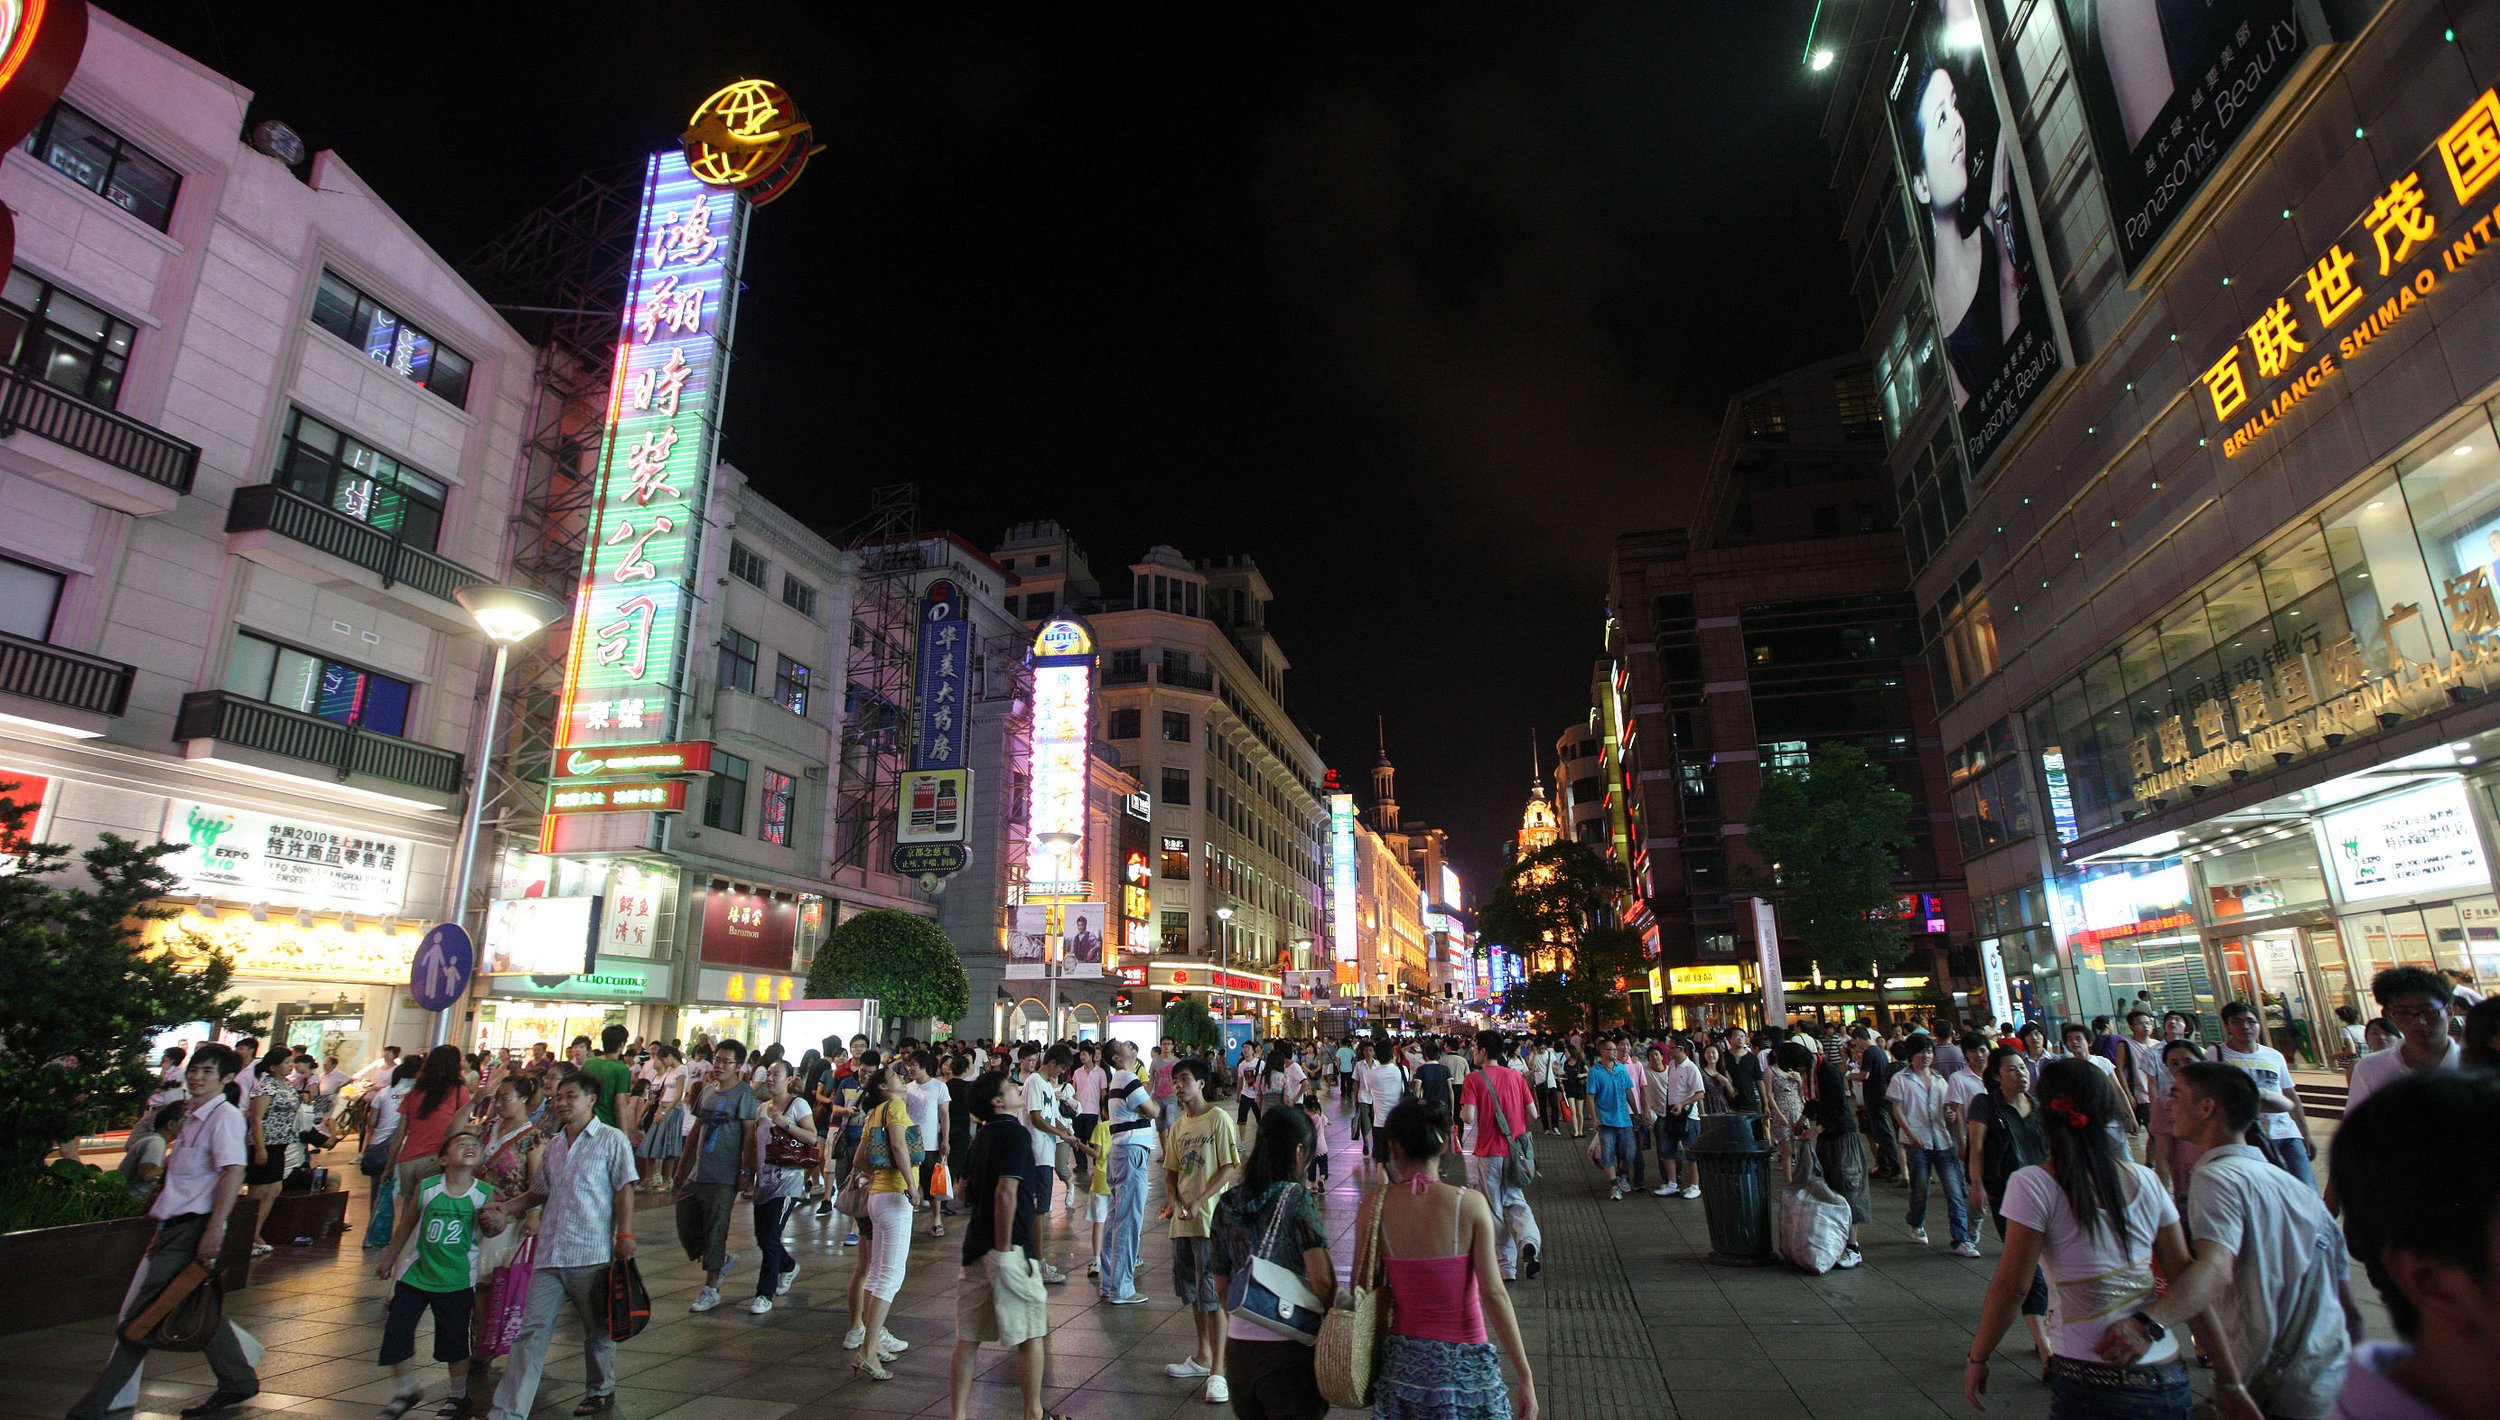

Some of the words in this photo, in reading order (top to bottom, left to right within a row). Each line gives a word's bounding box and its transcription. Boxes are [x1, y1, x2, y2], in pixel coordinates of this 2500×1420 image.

[2125, 121, 2216, 250] Panasonic
[2215, 5, 2297, 129] Beauty
[2222, 353, 2336, 459] BRILLIANCE
[2339, 269, 2436, 360] SHIMAO
[1970, 389, 2017, 460] Panasonic
[2015, 340, 2057, 399] Beauty
[928, 625, 960, 762] 华美大药房
[215, 848, 249, 860] EXPO
[266, 836, 396, 871] 特许商品零售店
[729, 925, 760, 939] Baromon
[1765, 940, 1776, 968] ROYAL
[426, 1218, 464, 1245] 02
[2121, 1368, 2146, 1386] Lee
